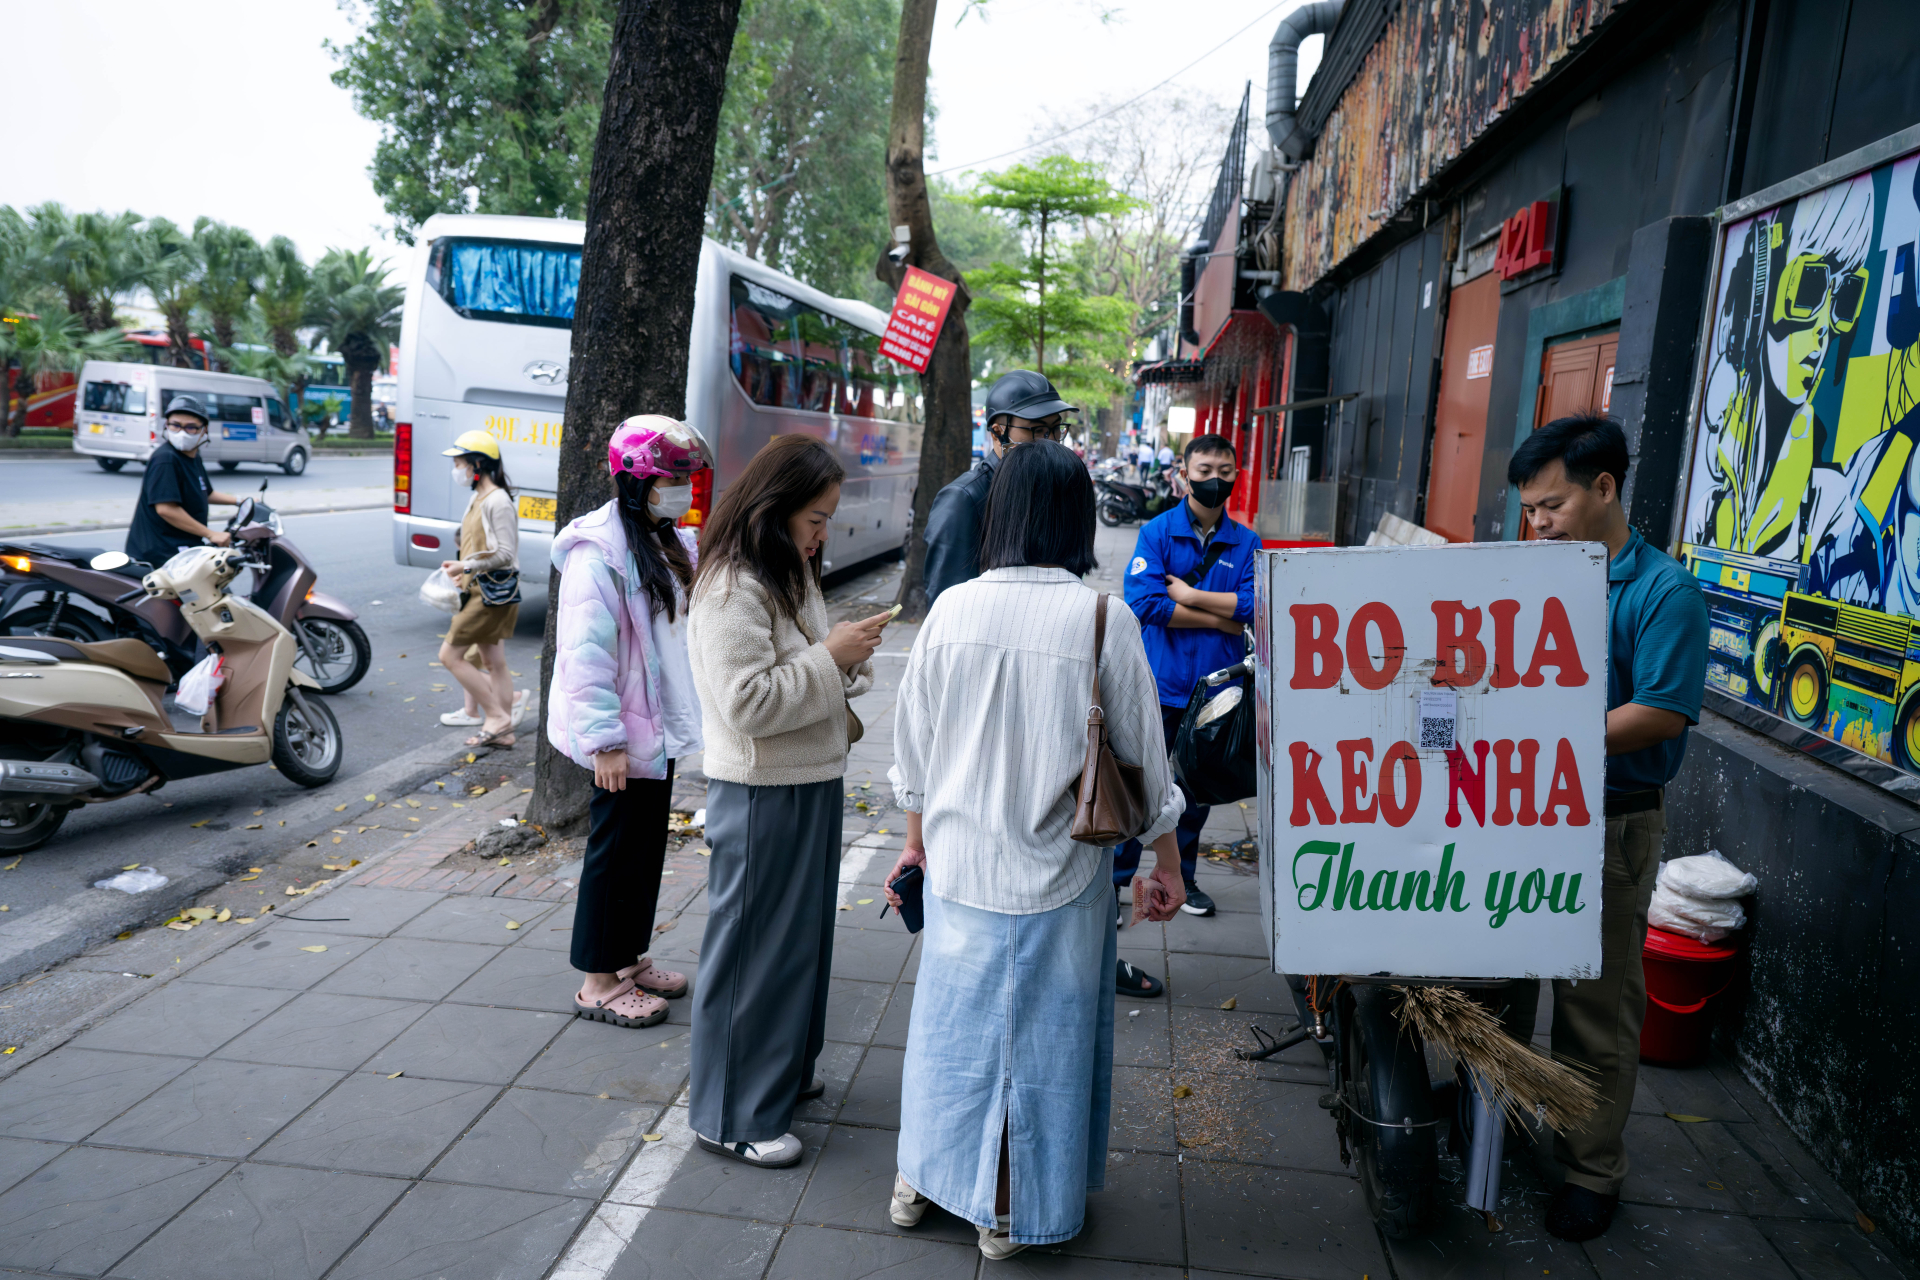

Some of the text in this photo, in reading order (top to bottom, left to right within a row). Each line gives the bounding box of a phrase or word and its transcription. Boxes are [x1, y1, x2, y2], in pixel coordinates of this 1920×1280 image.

[891, 320, 933, 344] PHA MÁY
[896, 309, 936, 332] CAFÉ
[883, 342, 911, 360] MANG
[1289, 601, 1404, 690] BO
[1431, 597, 1589, 688] BIA
[1289, 738, 1591, 828] KEO NHA
[1484, 868, 1586, 930] you
